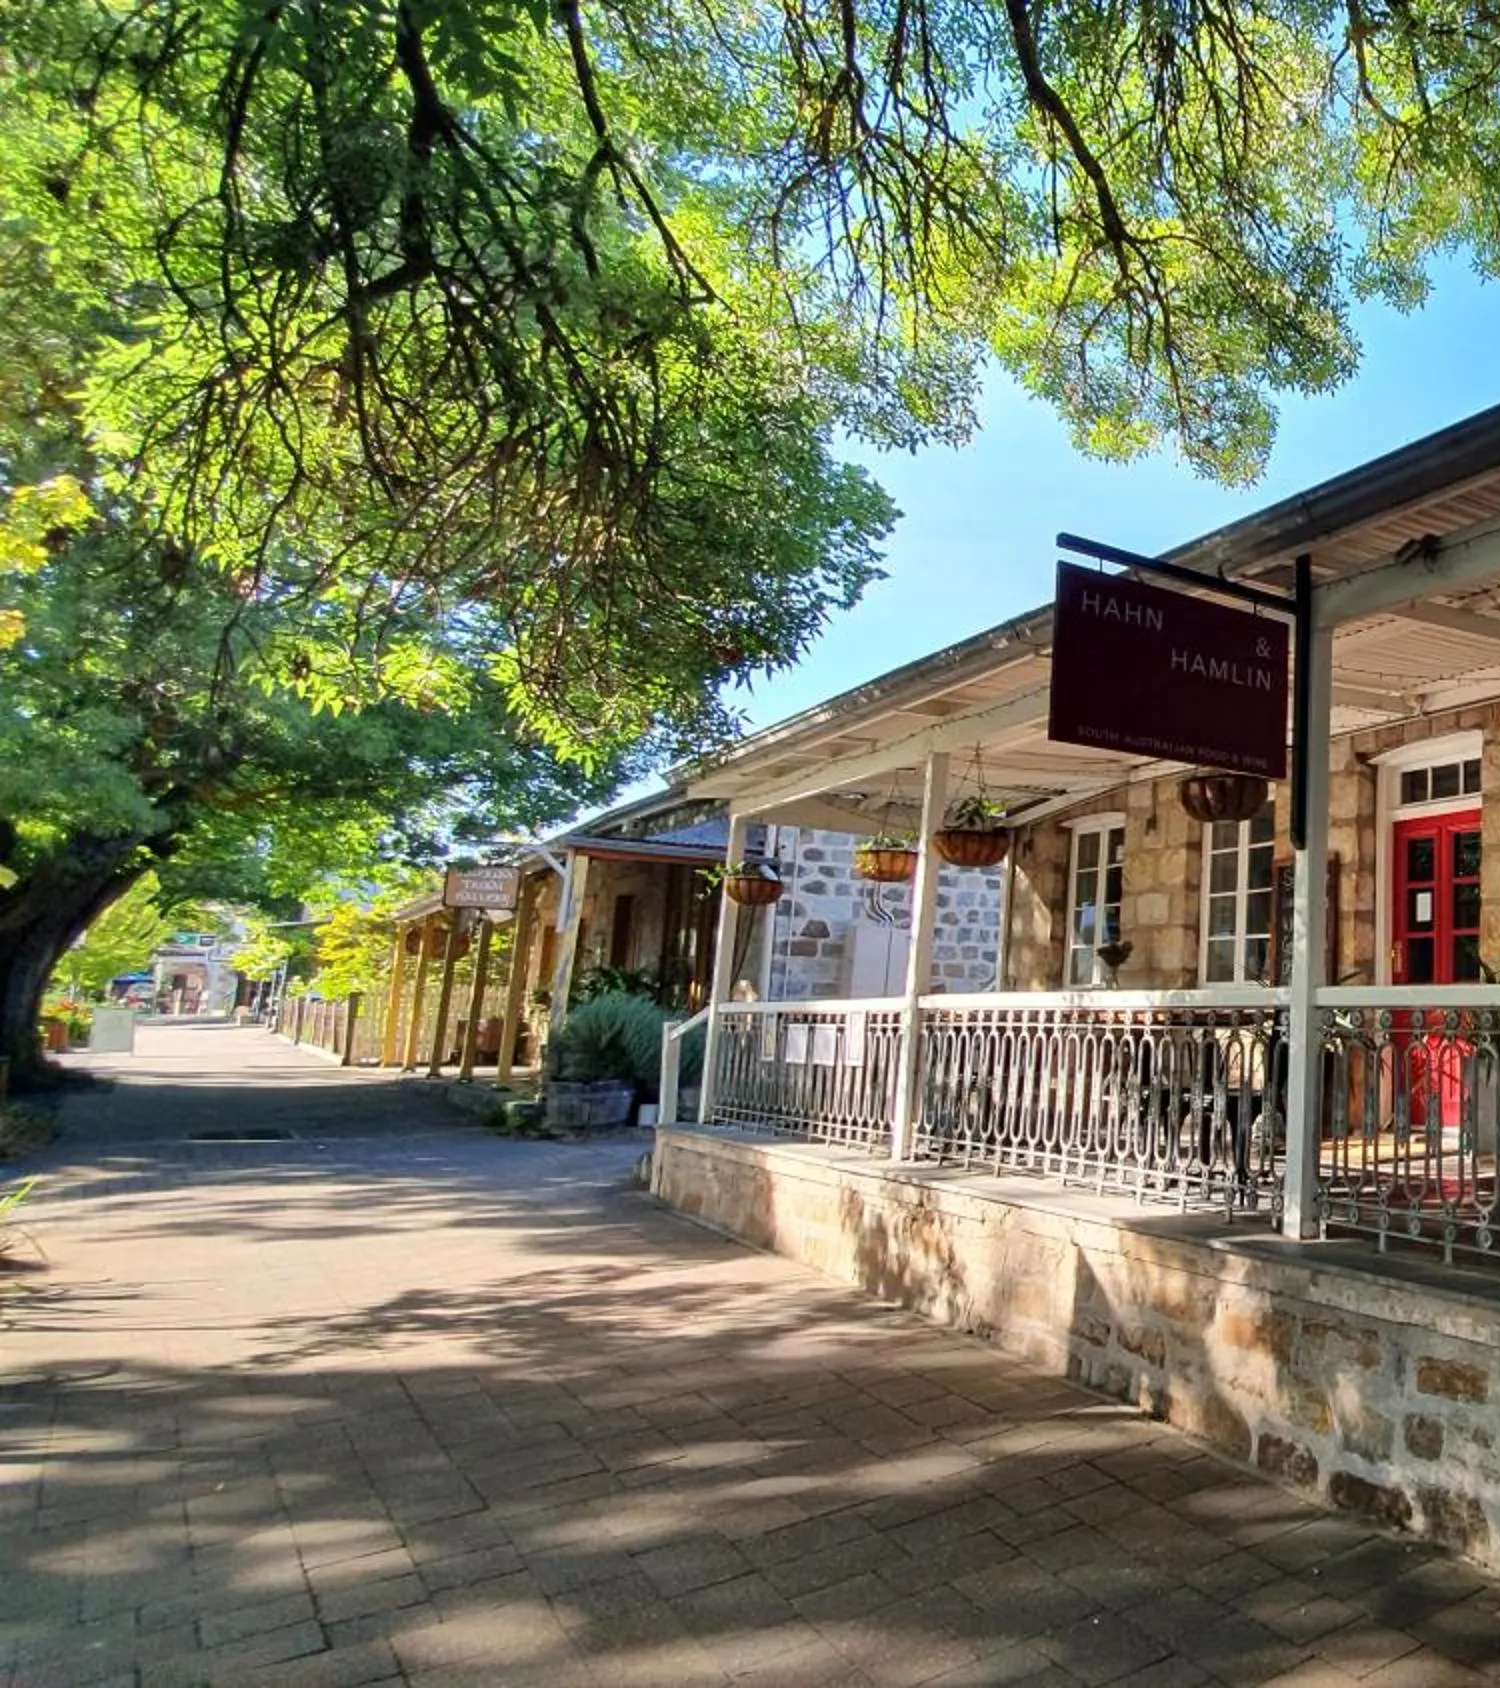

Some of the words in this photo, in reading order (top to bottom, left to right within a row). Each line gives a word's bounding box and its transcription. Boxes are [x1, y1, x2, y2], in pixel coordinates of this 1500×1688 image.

[1081, 590, 1165, 632] HAHN
[1255, 636, 1271, 660] &
[1170, 647, 1272, 692] HAMLIN
[1077, 724, 1119, 741] SOUTH
[1124, 735, 1195, 756] AUSTRALIAN
